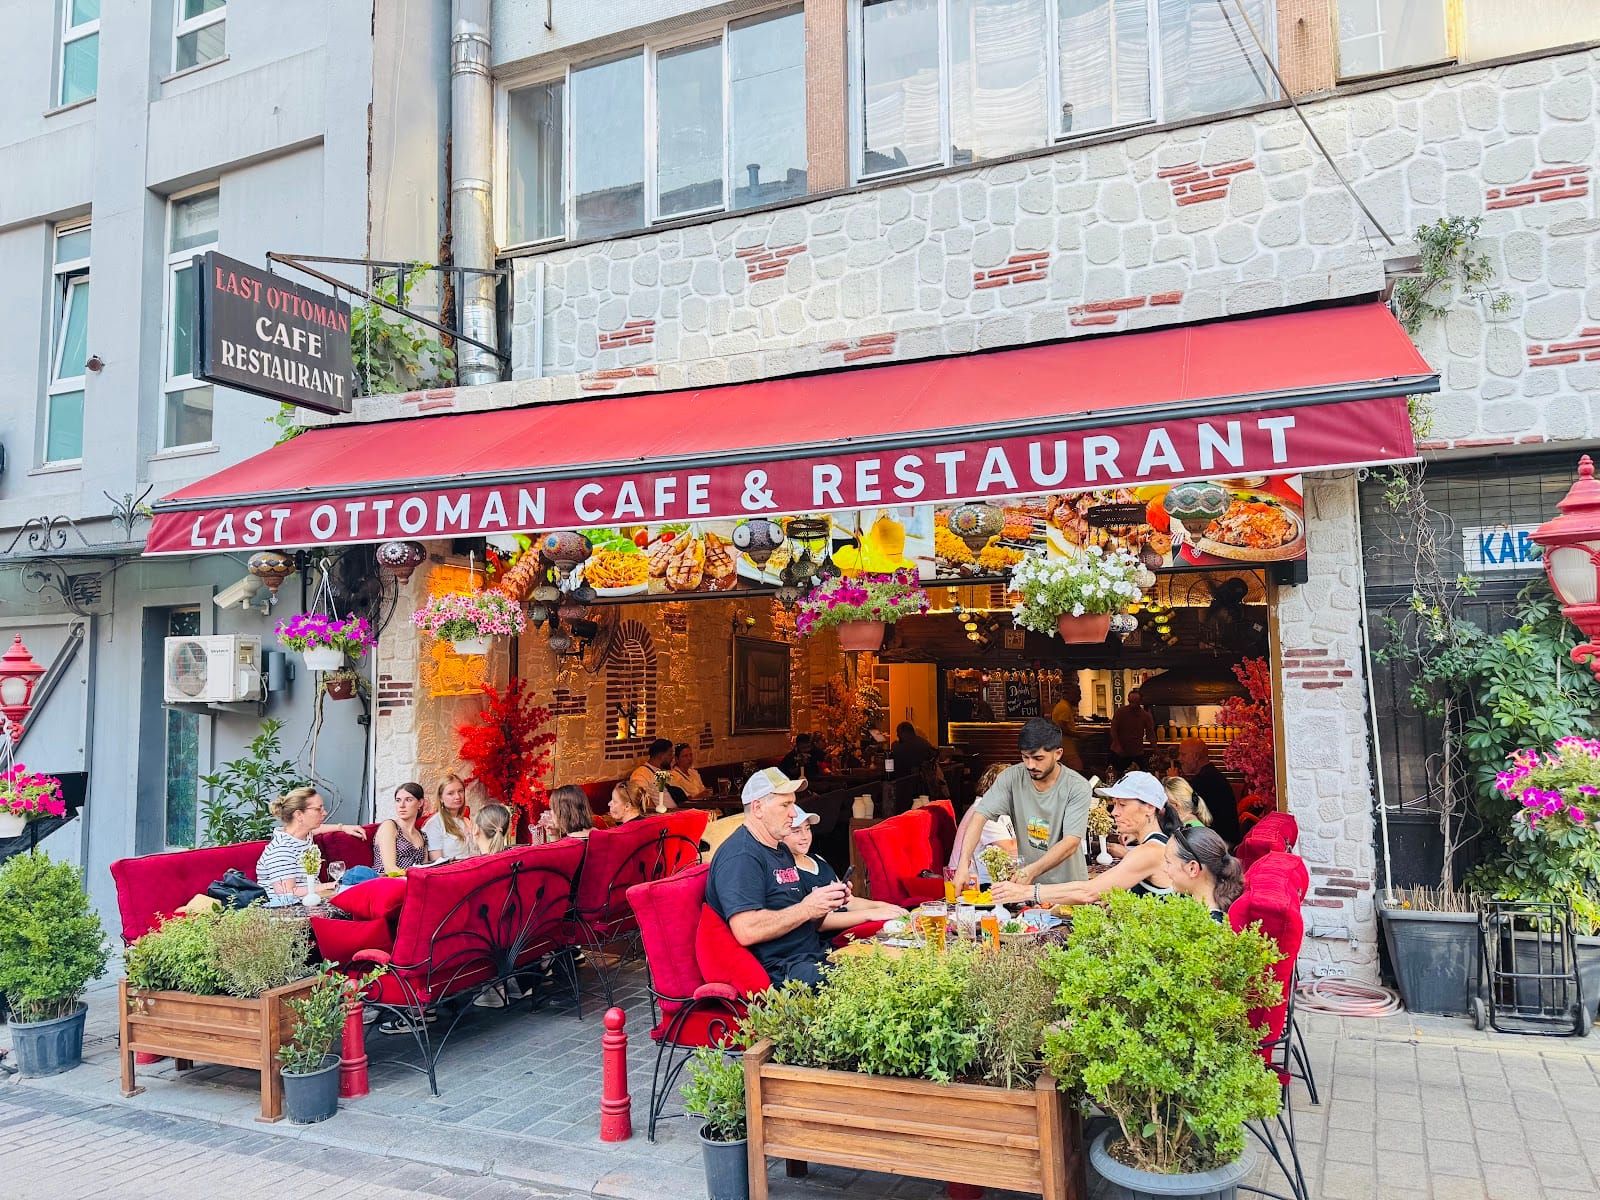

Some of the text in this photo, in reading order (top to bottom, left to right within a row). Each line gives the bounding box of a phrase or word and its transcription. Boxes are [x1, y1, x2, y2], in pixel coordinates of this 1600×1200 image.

[215, 267, 349, 334] LAST OTTOMAN
[255, 316, 322, 359] CAFE
[221, 339, 345, 398] RESTAURANT
[190, 415, 1296, 547] LAST OTTOMAN CAFE & RESTAURANT
[1478, 531, 1544, 564] KAR
